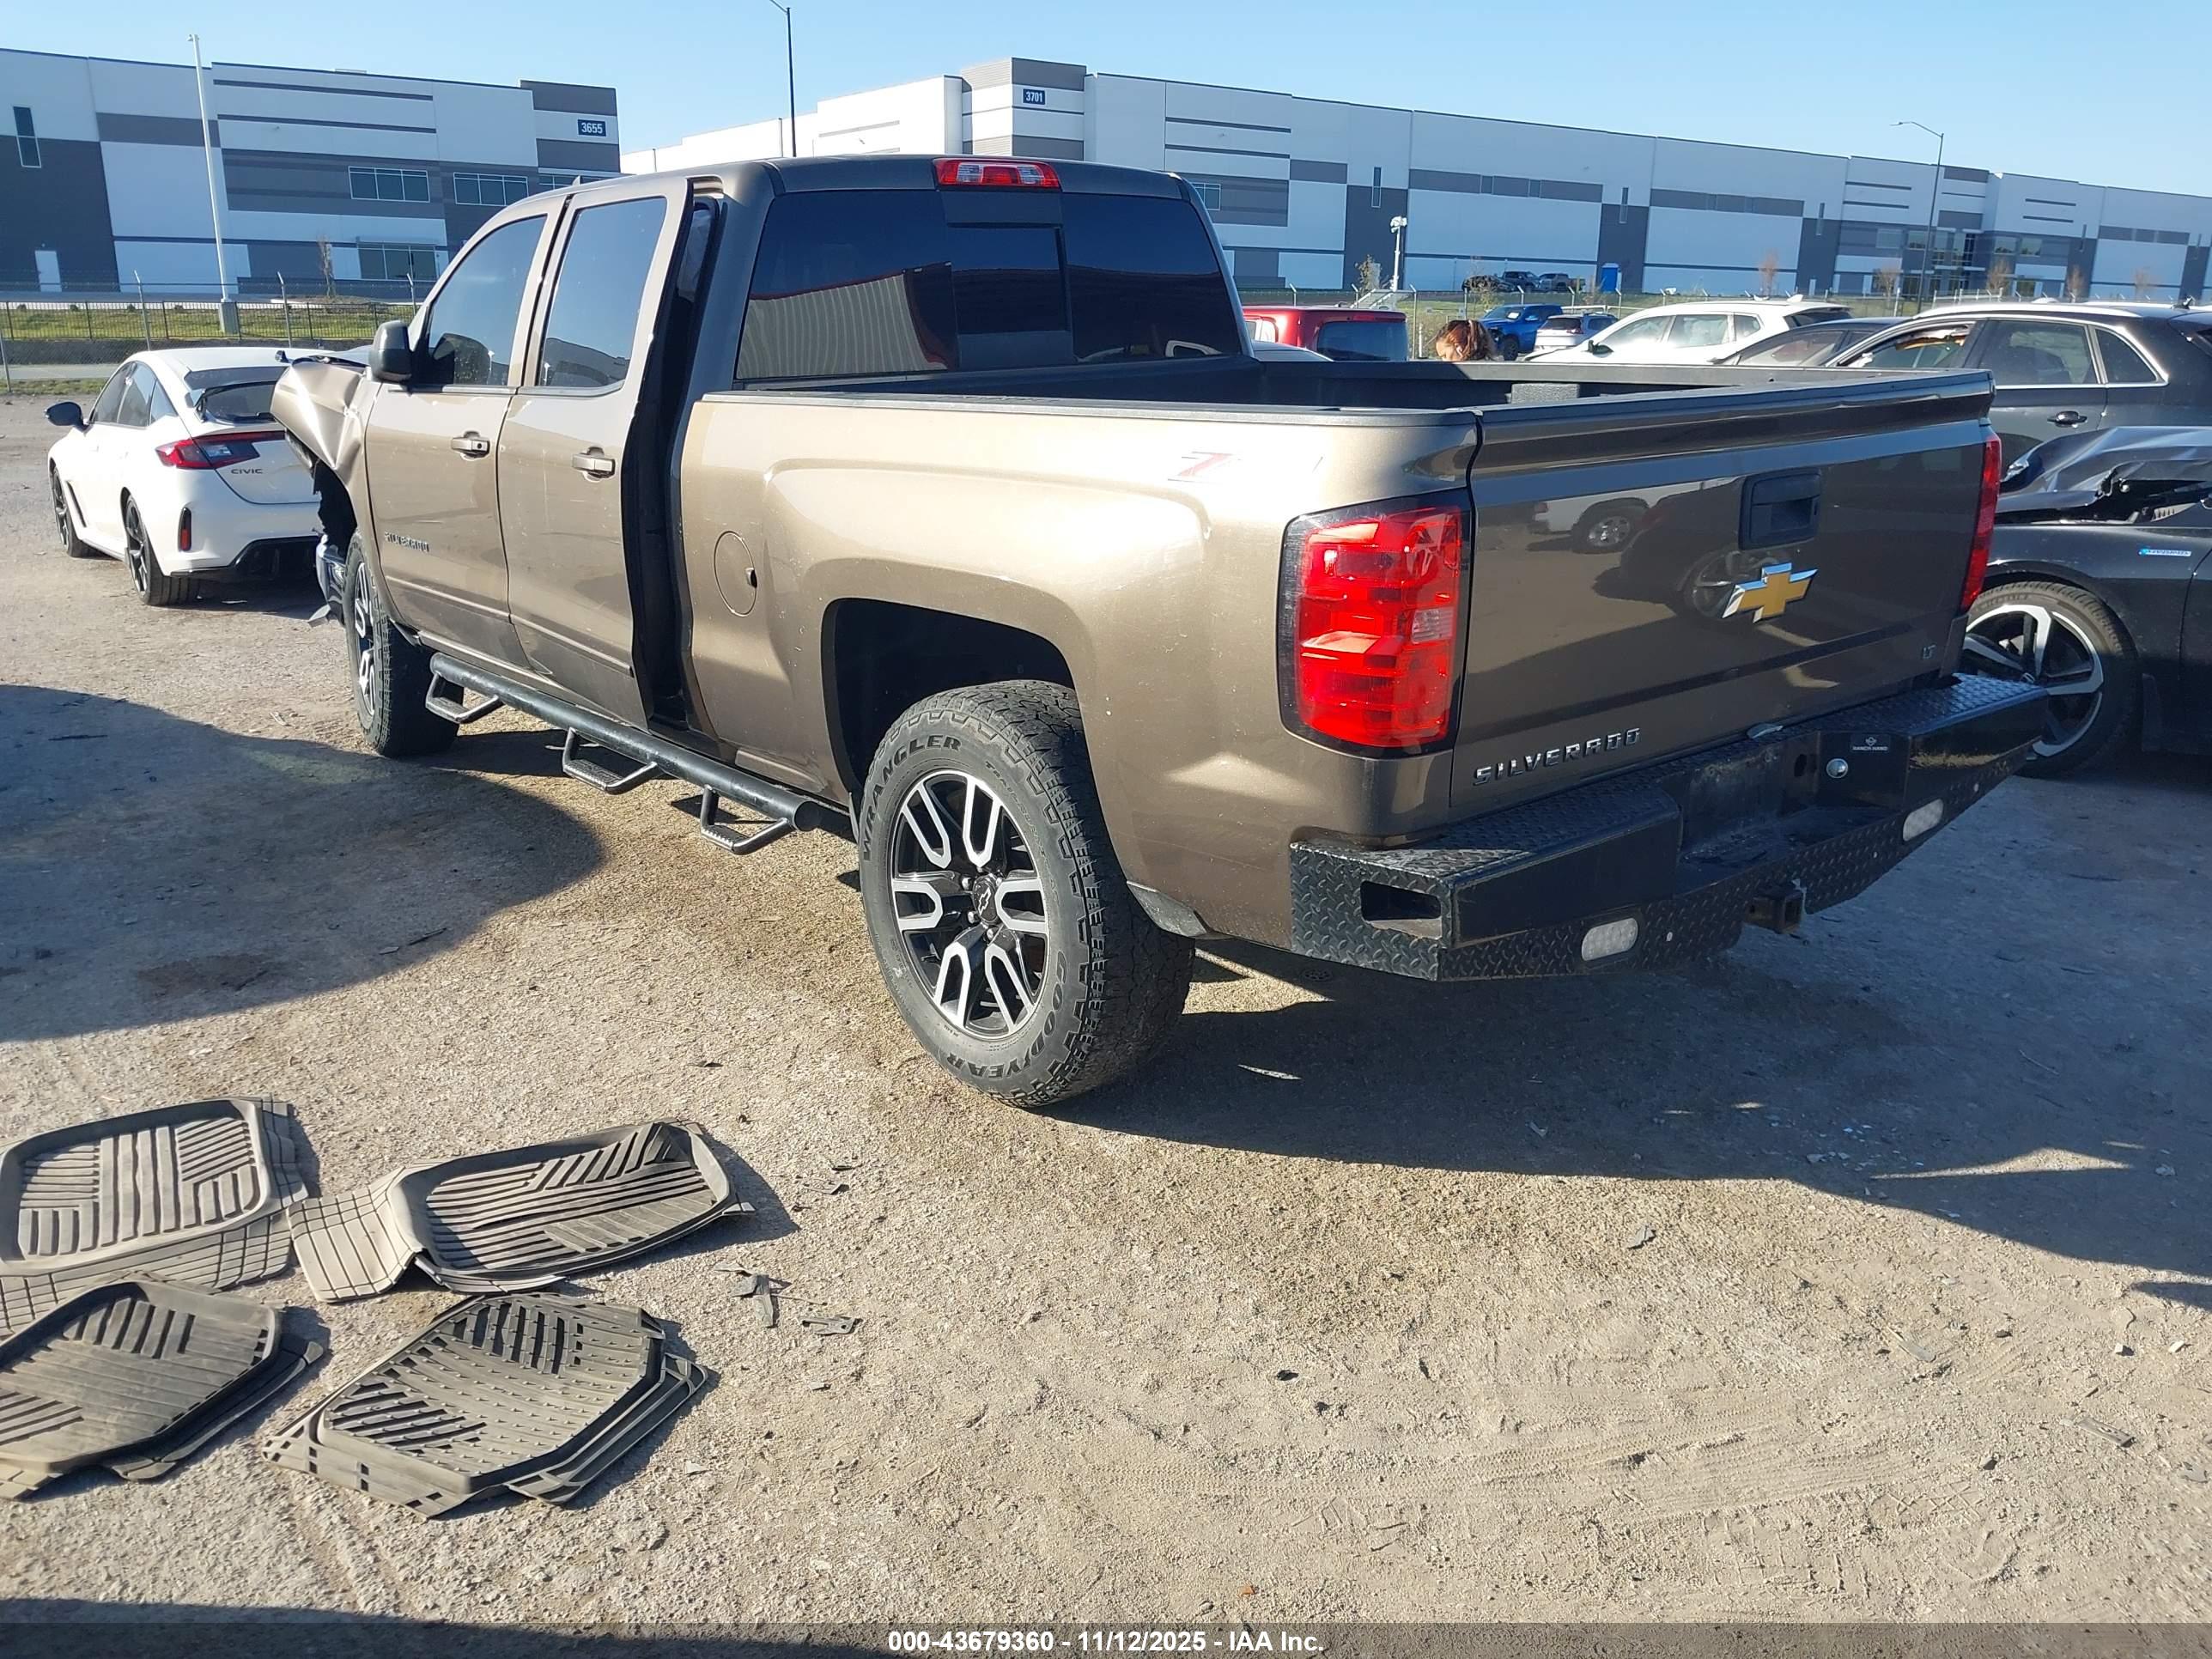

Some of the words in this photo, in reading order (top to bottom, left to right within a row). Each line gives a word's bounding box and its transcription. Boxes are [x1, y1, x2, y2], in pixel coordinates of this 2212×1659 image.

[1025, 91, 1043, 103] 3701
[581, 122, 603, 134] 3655
[1473, 727, 1641, 786] SILVERADO
[862, 734, 962, 861] WRANGLER
[946, 950, 1067, 1079] GOODYEAR
